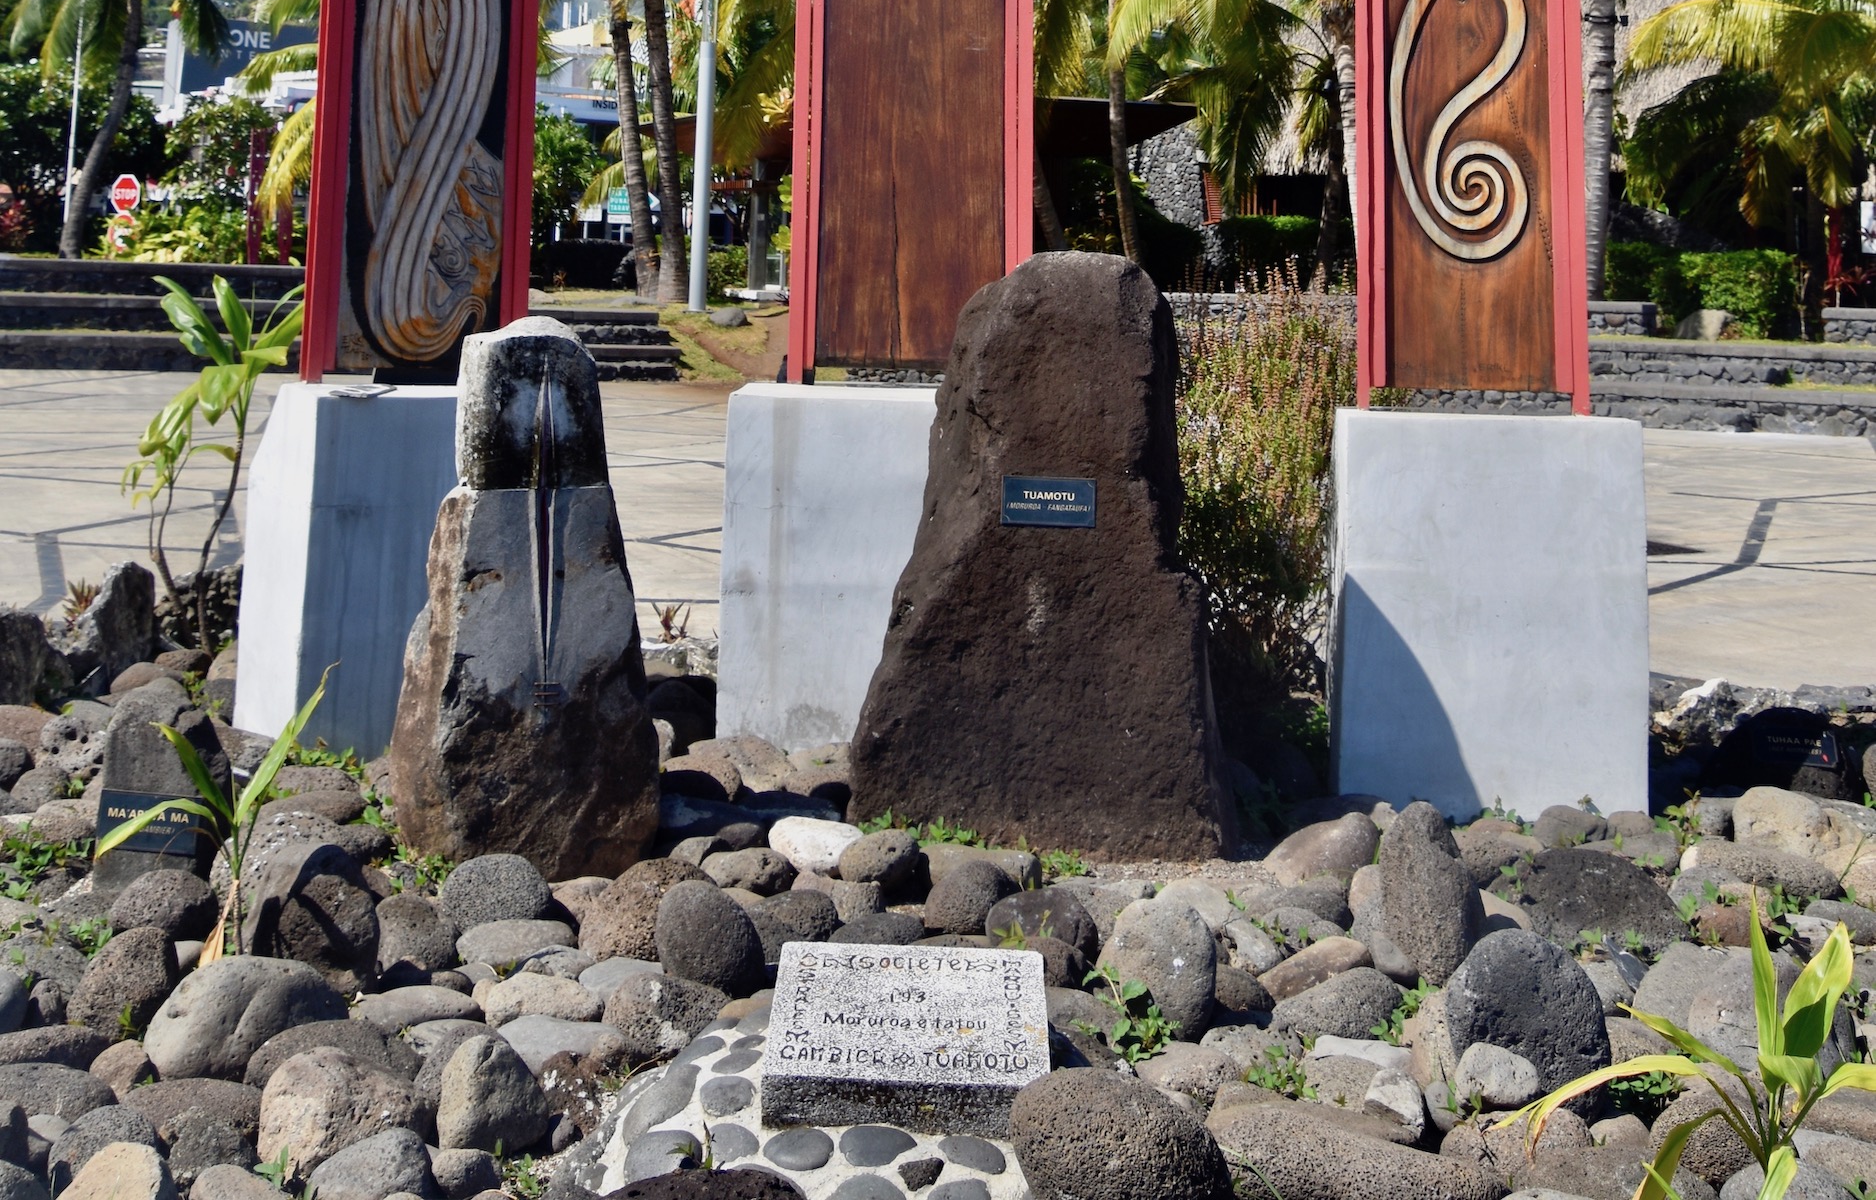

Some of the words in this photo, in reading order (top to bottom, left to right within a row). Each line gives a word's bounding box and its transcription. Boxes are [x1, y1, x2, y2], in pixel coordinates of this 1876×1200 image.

[229, 29, 272, 49] ONE
[592, 100, 618, 109] INSID
[115, 188, 137, 200] STOP
[1023, 490, 1075, 501] TUAMOTU
[170, 812, 189, 823] MA
